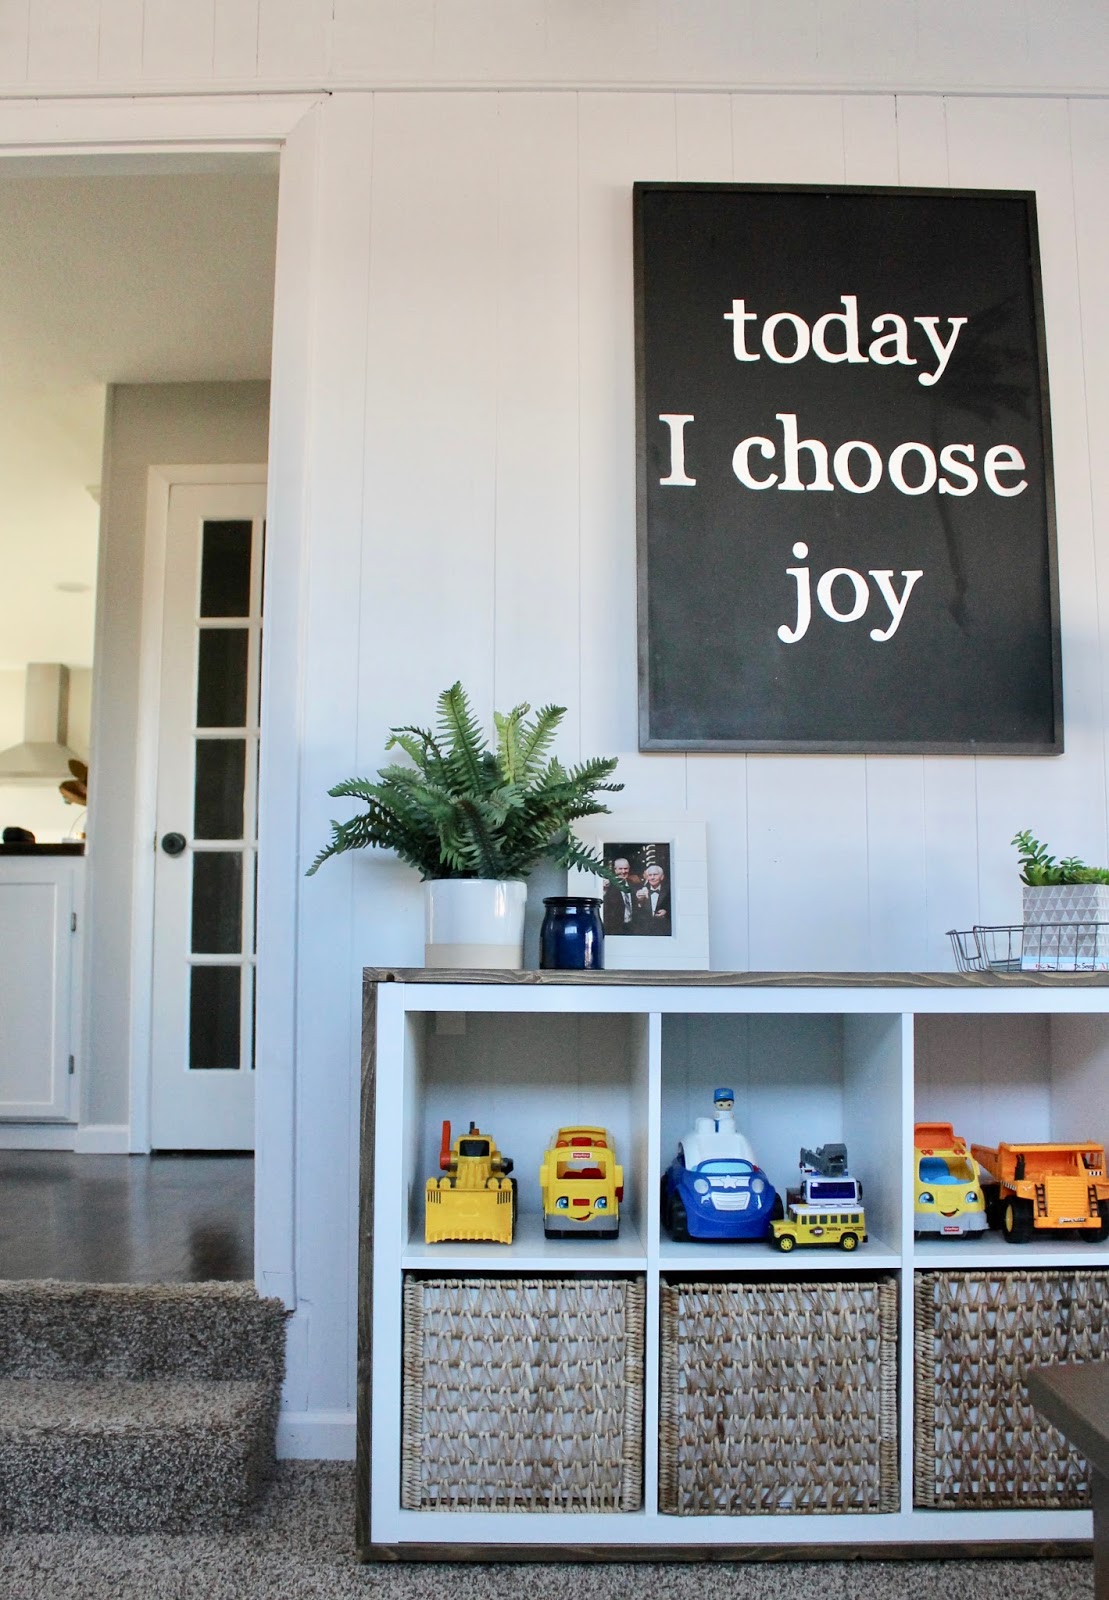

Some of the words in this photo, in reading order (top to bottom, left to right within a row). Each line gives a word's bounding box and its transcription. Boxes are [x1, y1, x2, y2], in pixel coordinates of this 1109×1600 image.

[723, 295, 968, 387] today
[658, 413, 697, 487] I
[731, 413, 1029, 498] choose
[776, 541, 924, 644] joy
